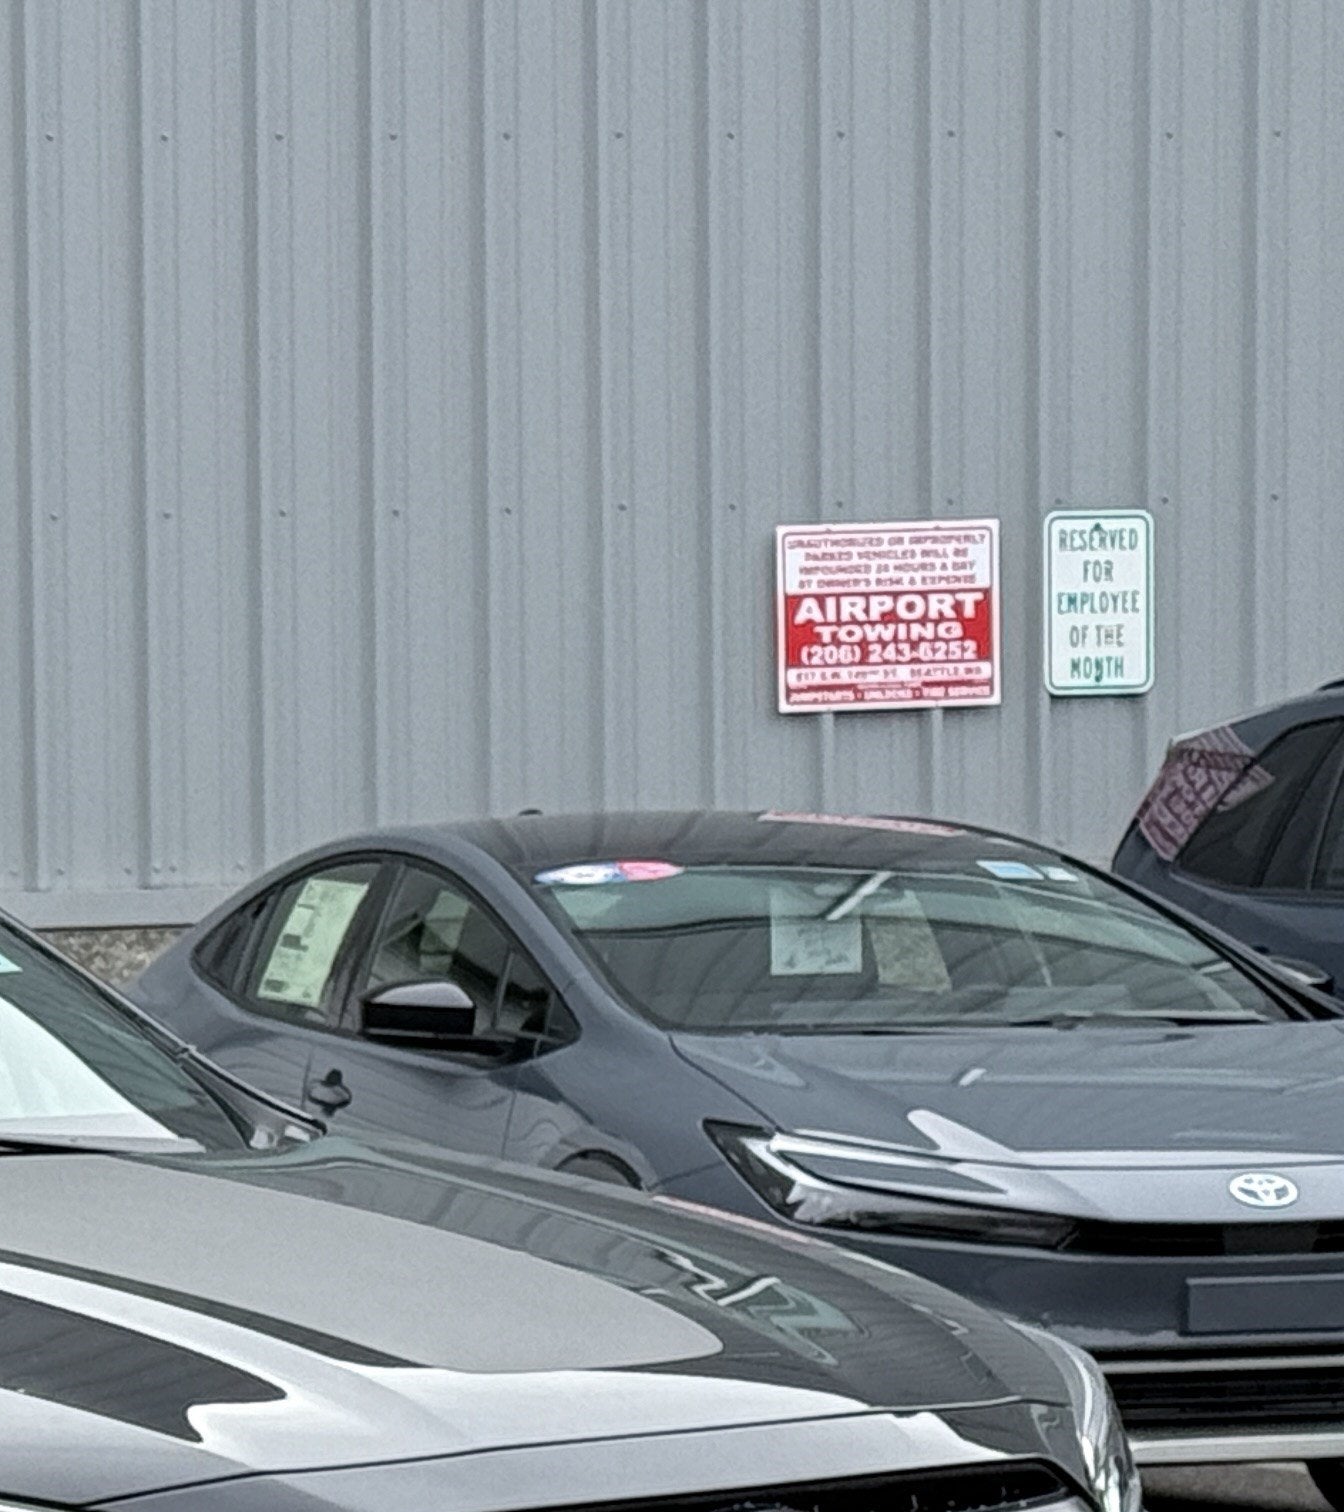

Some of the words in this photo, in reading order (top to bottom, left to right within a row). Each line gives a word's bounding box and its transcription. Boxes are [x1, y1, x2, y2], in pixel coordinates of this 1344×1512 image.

[1058, 528, 1139, 552] RESERVED
[1083, 559, 1115, 583] FOR
[794, 592, 985, 625] AIRPORT
[1057, 590, 1141, 615] EMPLOYEE
[814, 621, 964, 644] TOWING
[1069, 624, 1089, 648] OF
[1094, 623, 1125, 648] THE
[1070, 656, 1125, 680] MONTH
